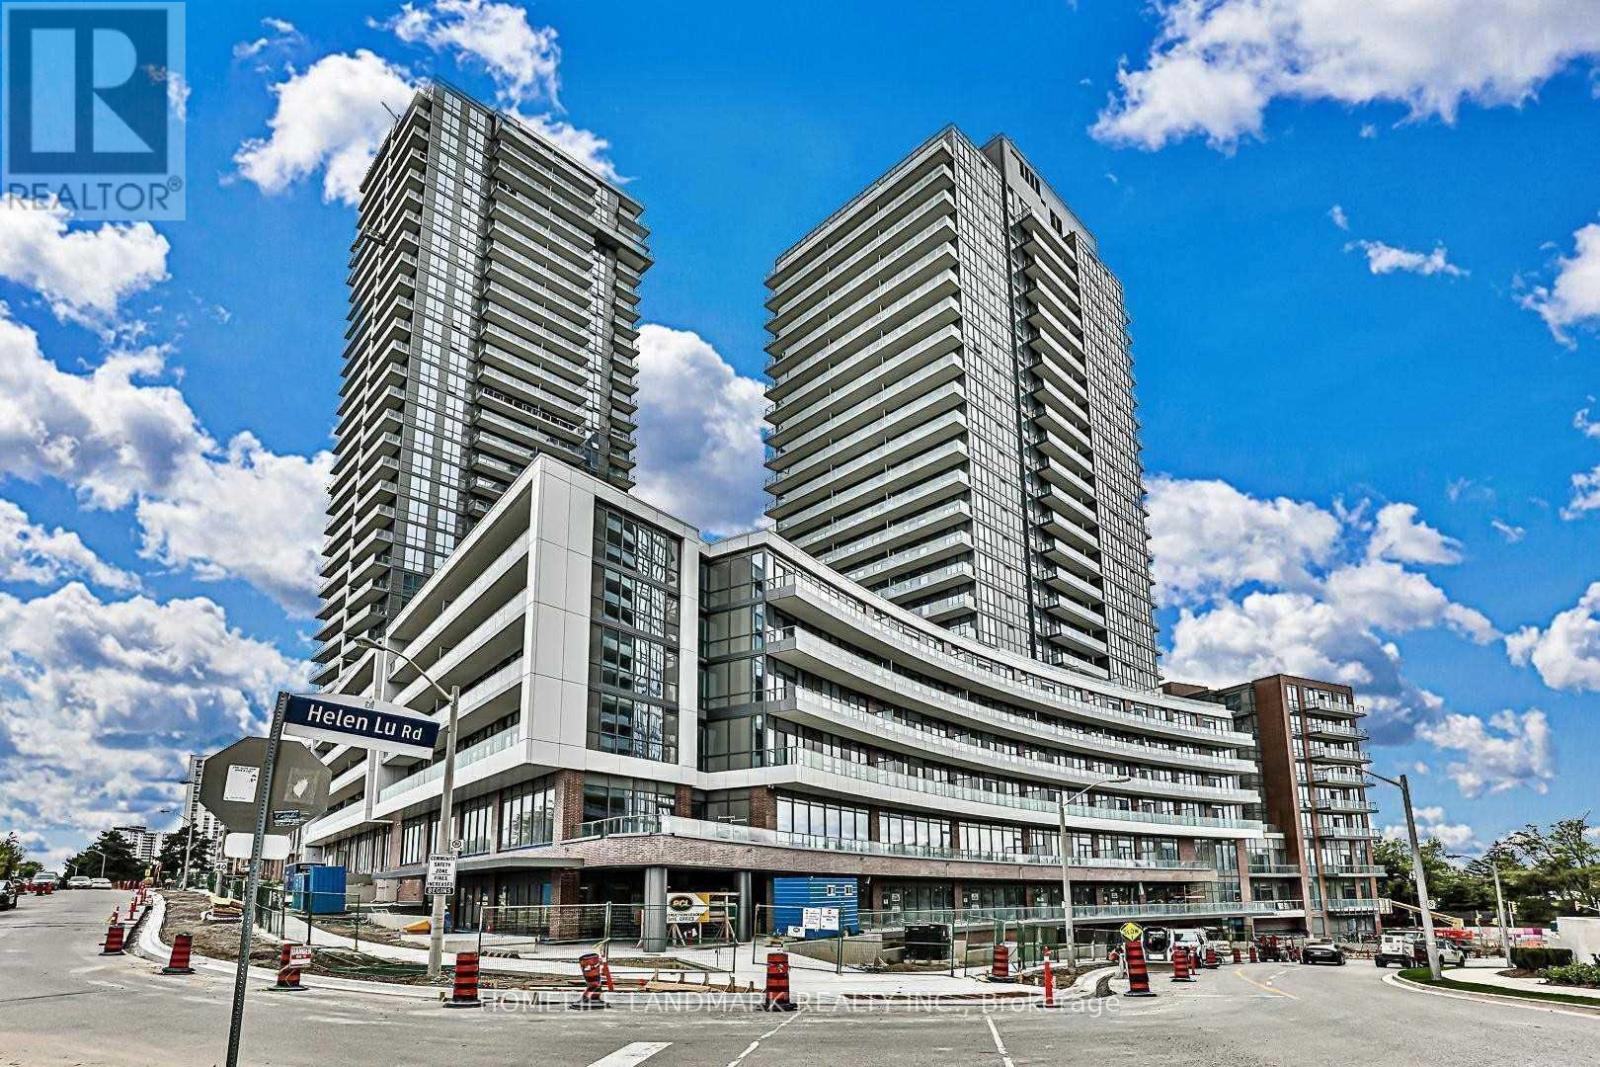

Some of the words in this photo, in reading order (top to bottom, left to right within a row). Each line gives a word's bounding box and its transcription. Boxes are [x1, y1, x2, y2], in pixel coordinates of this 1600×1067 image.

[307, 704, 368, 731] Helen
[374, 716, 397, 736] Lu
[401, 724, 423, 741] Rd
